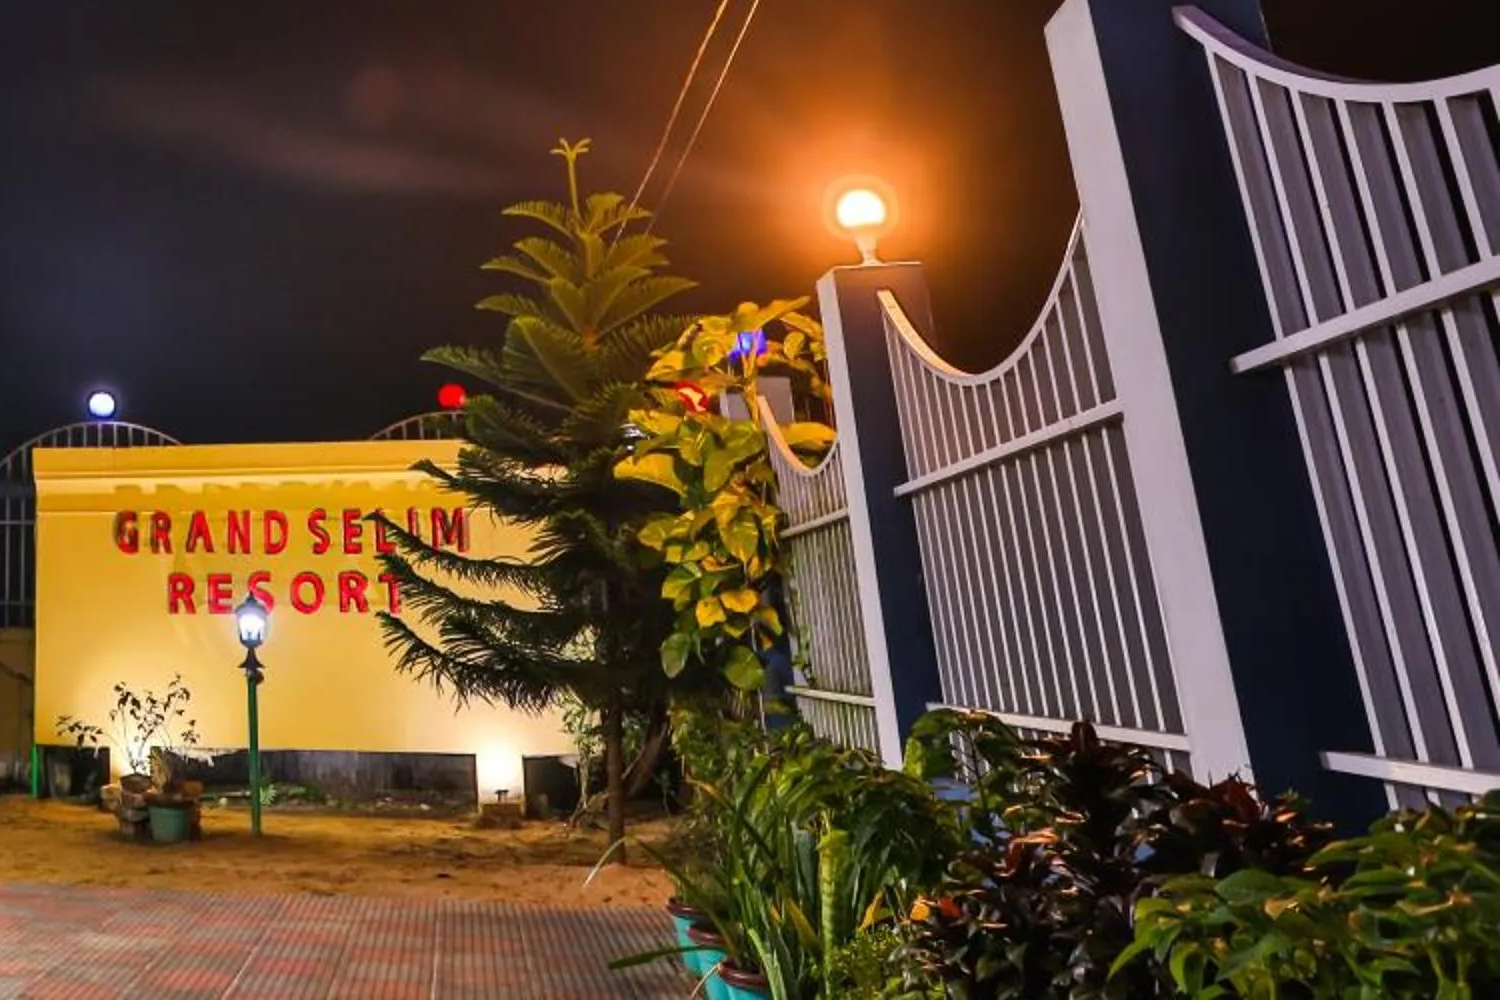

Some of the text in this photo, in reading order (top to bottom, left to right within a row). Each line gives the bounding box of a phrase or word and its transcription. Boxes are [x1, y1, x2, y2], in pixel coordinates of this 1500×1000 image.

[114, 507, 470, 554] GRAND SELIM
[167, 570, 401, 614] RESORT
